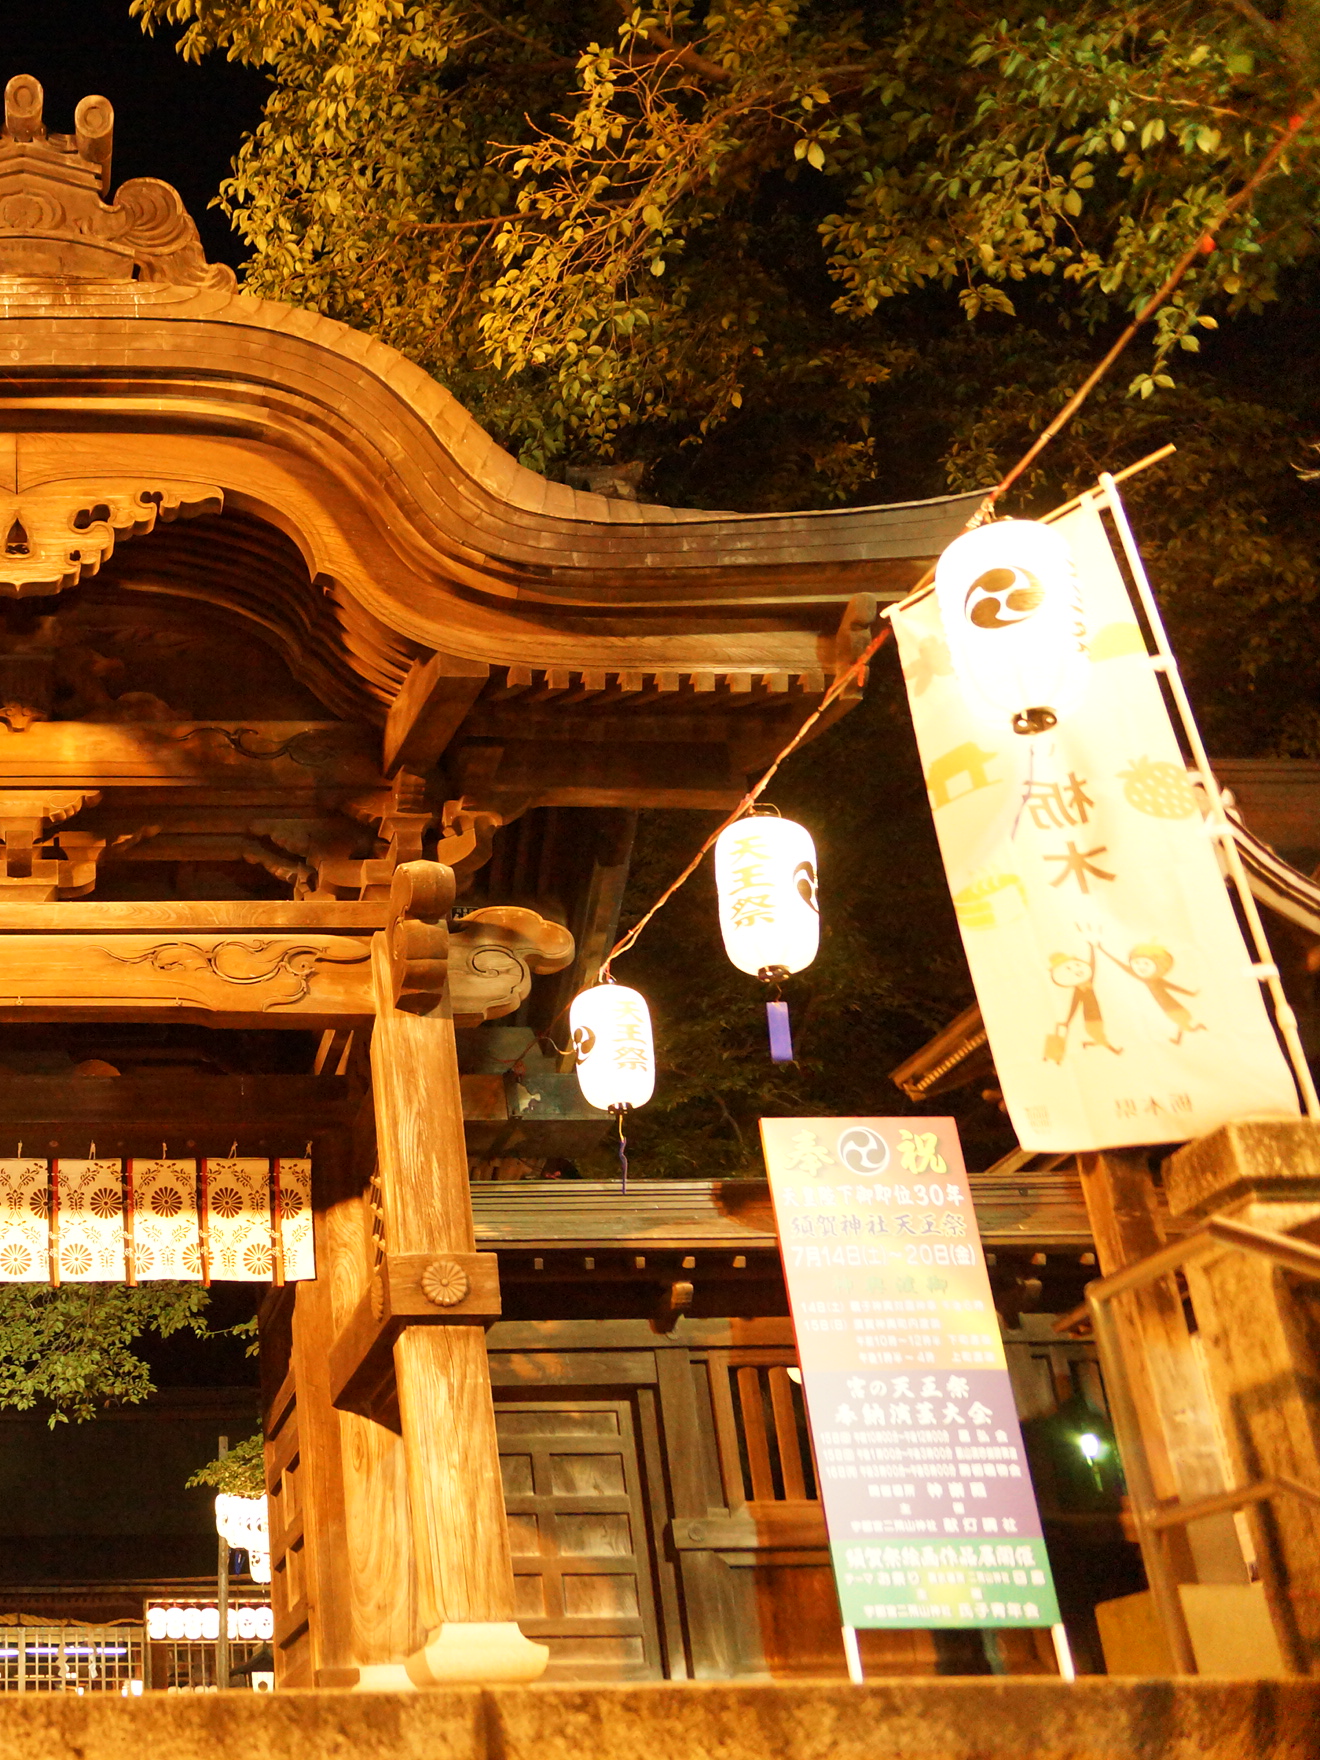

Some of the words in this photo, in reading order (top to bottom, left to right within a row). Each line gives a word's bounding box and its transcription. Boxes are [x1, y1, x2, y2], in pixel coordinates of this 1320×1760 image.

[728, 835, 776, 931] 天王祭
[611, 1000, 649, 1072] 天王祭
[784, 1128, 835, 1176] 奉
[896, 1129, 949, 1175] 祝
[782, 1183, 965, 1207] 天皇陛下御即位30年
[790, 1213, 968, 1238] 須賀神社天王祭
[846, 1374, 970, 1399] 宮の天王祭
[834, 1401, 993, 1427] 奉納演芸大会
